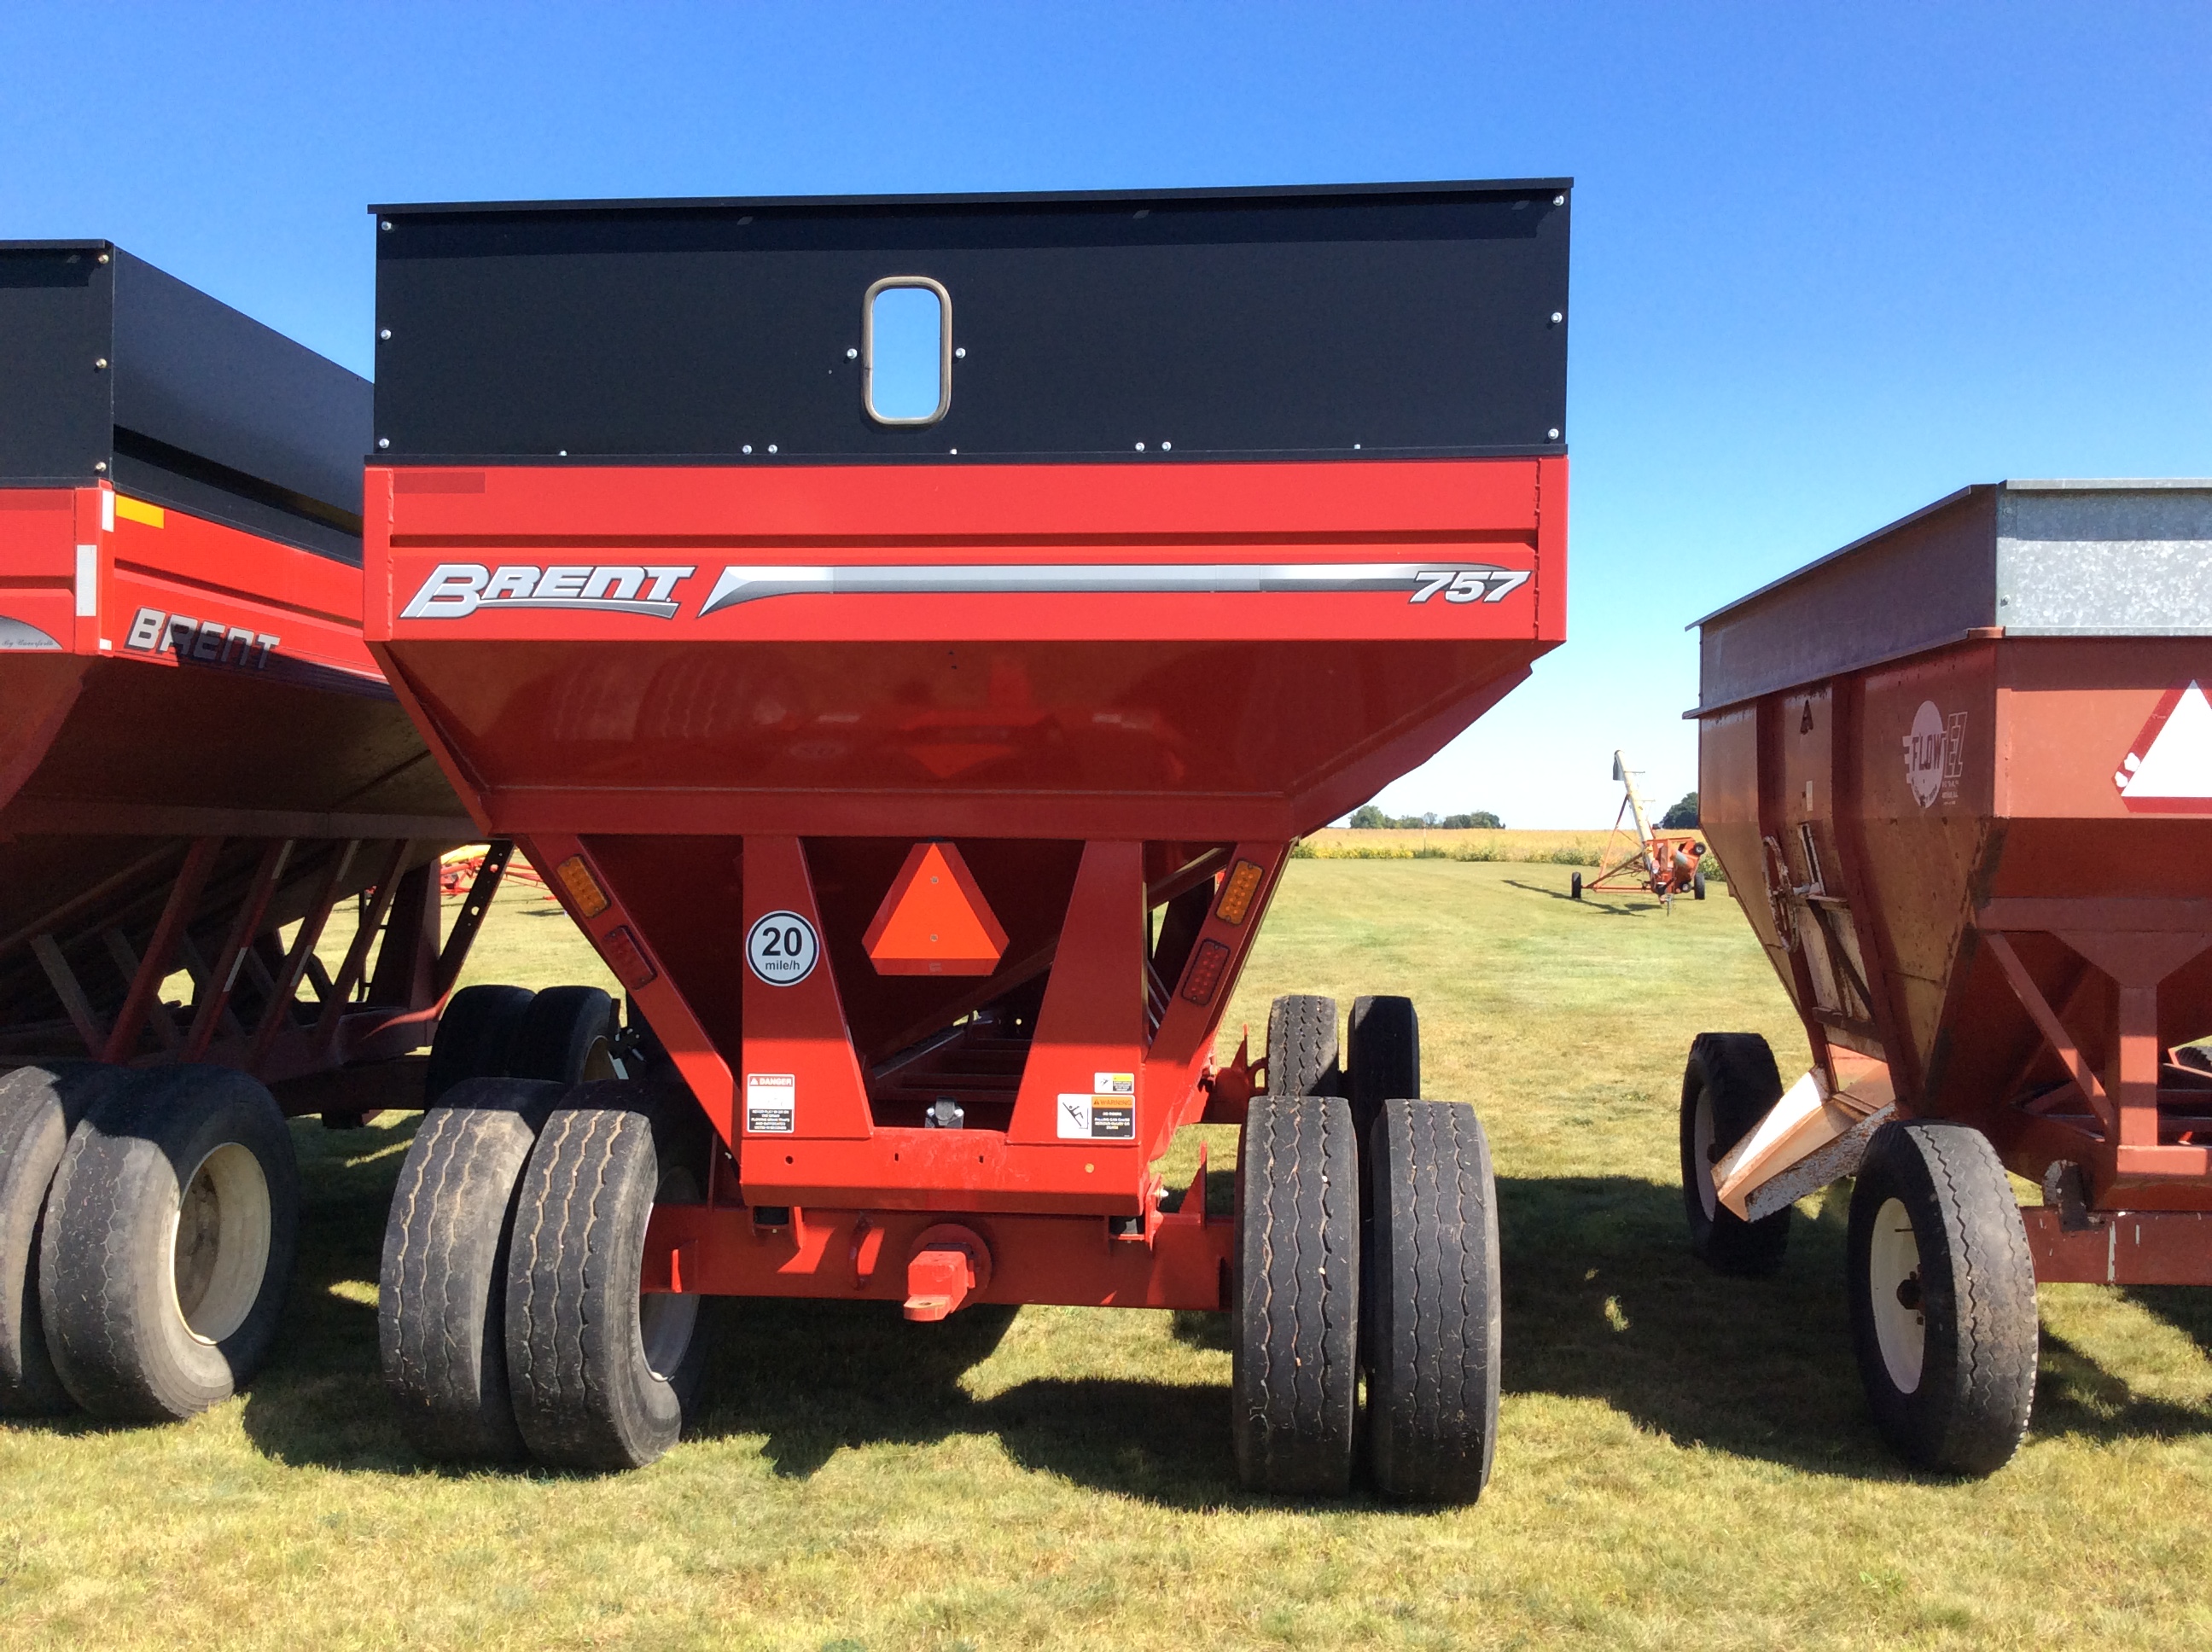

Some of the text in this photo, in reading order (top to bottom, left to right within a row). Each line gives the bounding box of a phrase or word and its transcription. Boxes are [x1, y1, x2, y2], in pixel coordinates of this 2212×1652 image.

[399, 562, 698, 620] BRENT
[1408, 570, 1534, 604] 757
[127, 607, 281, 670] BRENT
[1912, 733, 1945, 771] FLOW
[762, 927, 803, 957] 20
[765, 959, 800, 970] mile/h
[759, 1077, 792, 1085] DANGER
